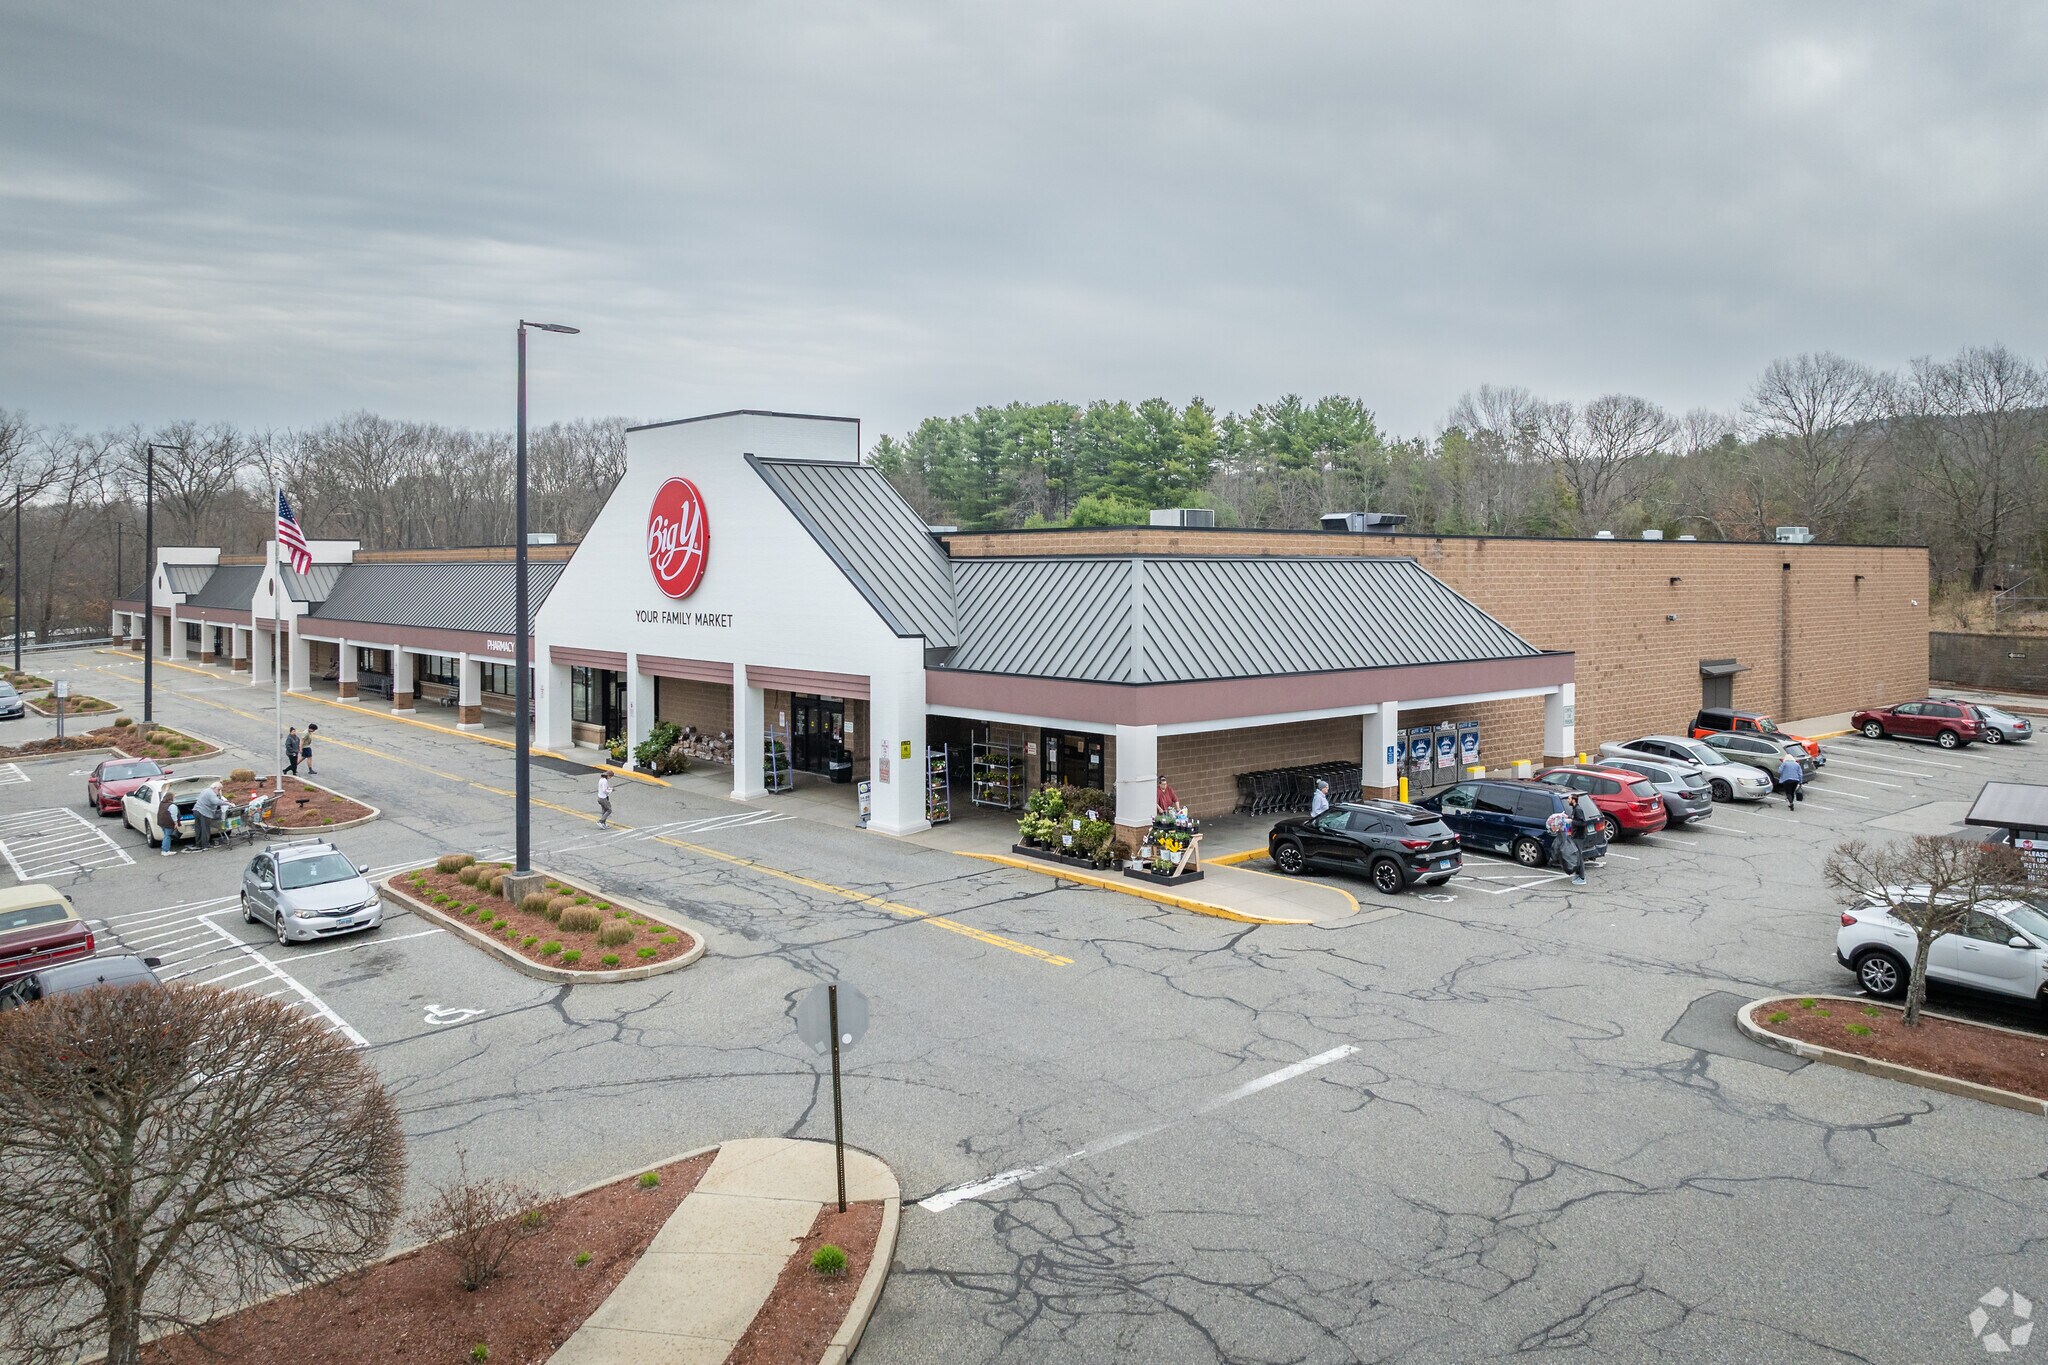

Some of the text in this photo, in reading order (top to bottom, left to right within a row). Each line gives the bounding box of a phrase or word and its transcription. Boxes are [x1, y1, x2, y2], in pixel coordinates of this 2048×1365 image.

[648, 515, 679, 570] Big
[636, 610, 733, 627] YOUR FAMILY MARKET
[487, 640, 515, 652] PHARMACY
